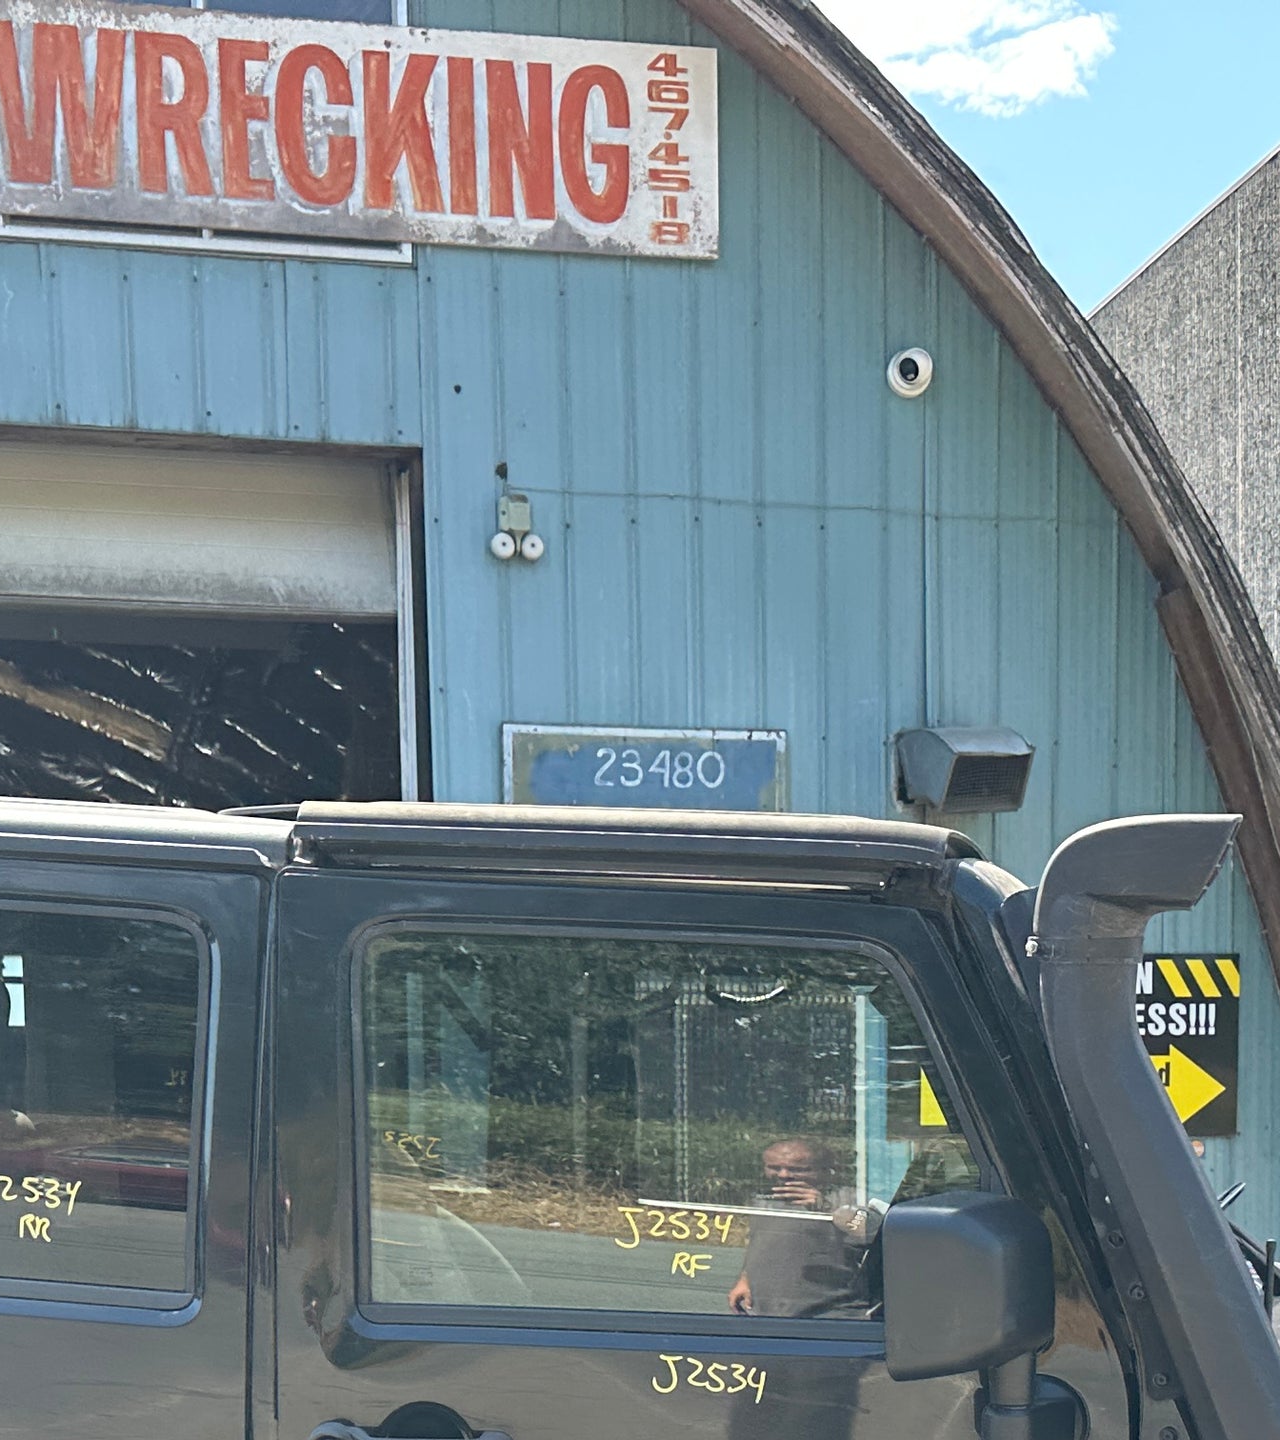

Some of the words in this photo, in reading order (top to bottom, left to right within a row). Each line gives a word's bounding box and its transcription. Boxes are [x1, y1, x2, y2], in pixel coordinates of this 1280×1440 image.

[594, 748, 725, 788] 23480
[1135, 1003, 1217, 1036] ESS!!!
[614, 1206, 734, 1249] J2534
[671, 1252, 712, 1278] RF
[652, 1354, 767, 1405] J2534
